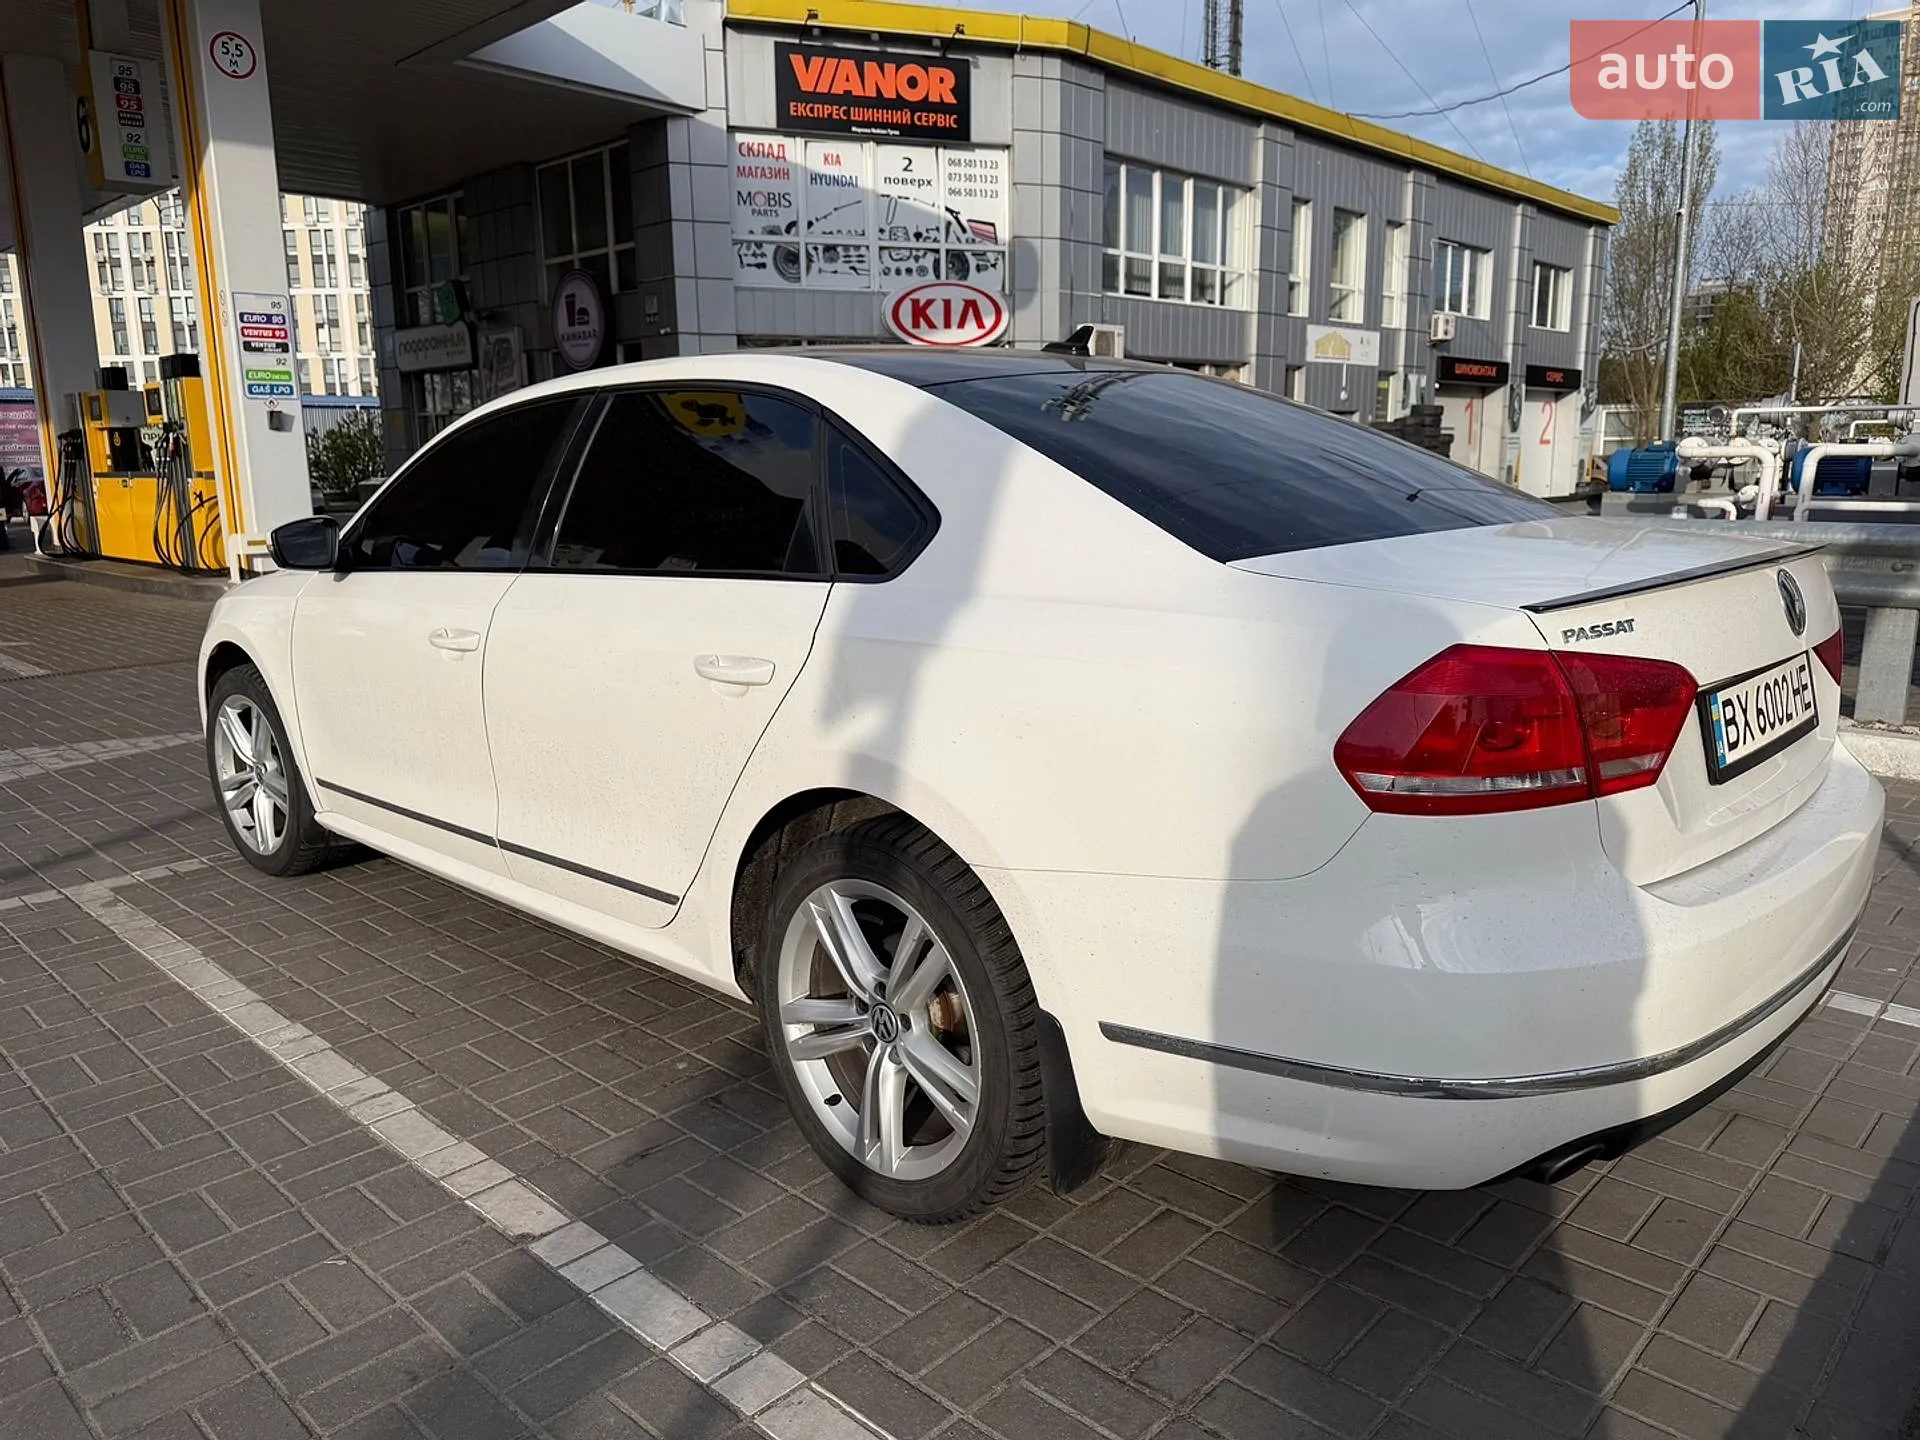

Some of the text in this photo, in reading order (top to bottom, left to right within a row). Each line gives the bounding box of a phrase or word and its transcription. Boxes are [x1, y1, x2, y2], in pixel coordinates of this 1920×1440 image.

[221, 40, 244, 58] 5,5
[118, 65, 133, 76] 95
[788, 53, 957, 104] VIANOR
[119, 82, 135, 93] 95
[120, 99, 138, 110] 95
[789, 102, 958, 128] ЕКСПРЕС ШИННИЙ СЕРВІС
[126, 133, 141, 144] 92
[738, 141, 787, 161] СКЛАД
[902, 157, 914, 173] 2
[948, 157, 999, 170] 068 503 13 23
[736, 165, 790, 181] МАГАЗИН
[948, 172, 999, 184] 073 503 13 23
[810, 172, 858, 188] HYUNDAI
[883, 176, 933, 188] поверх
[948, 187, 999, 199] 066 503 13 23
[737, 190, 792, 209] MOBIS
[751, 208, 779, 218] PARTS
[270, 300, 282, 310] 95
[243, 314, 284, 324] EURO 95
[909, 298, 986, 330] KIA
[243, 328, 272, 337] VENTUS
[275, 357, 287, 367] 92
[247, 371, 271, 380] EURO
[273, 386, 290, 394] LPG
[1539, 400, 1553, 445] 2
[1561, 617, 1635, 645] PASSAT
[1756, 673, 1793, 735] 6002
